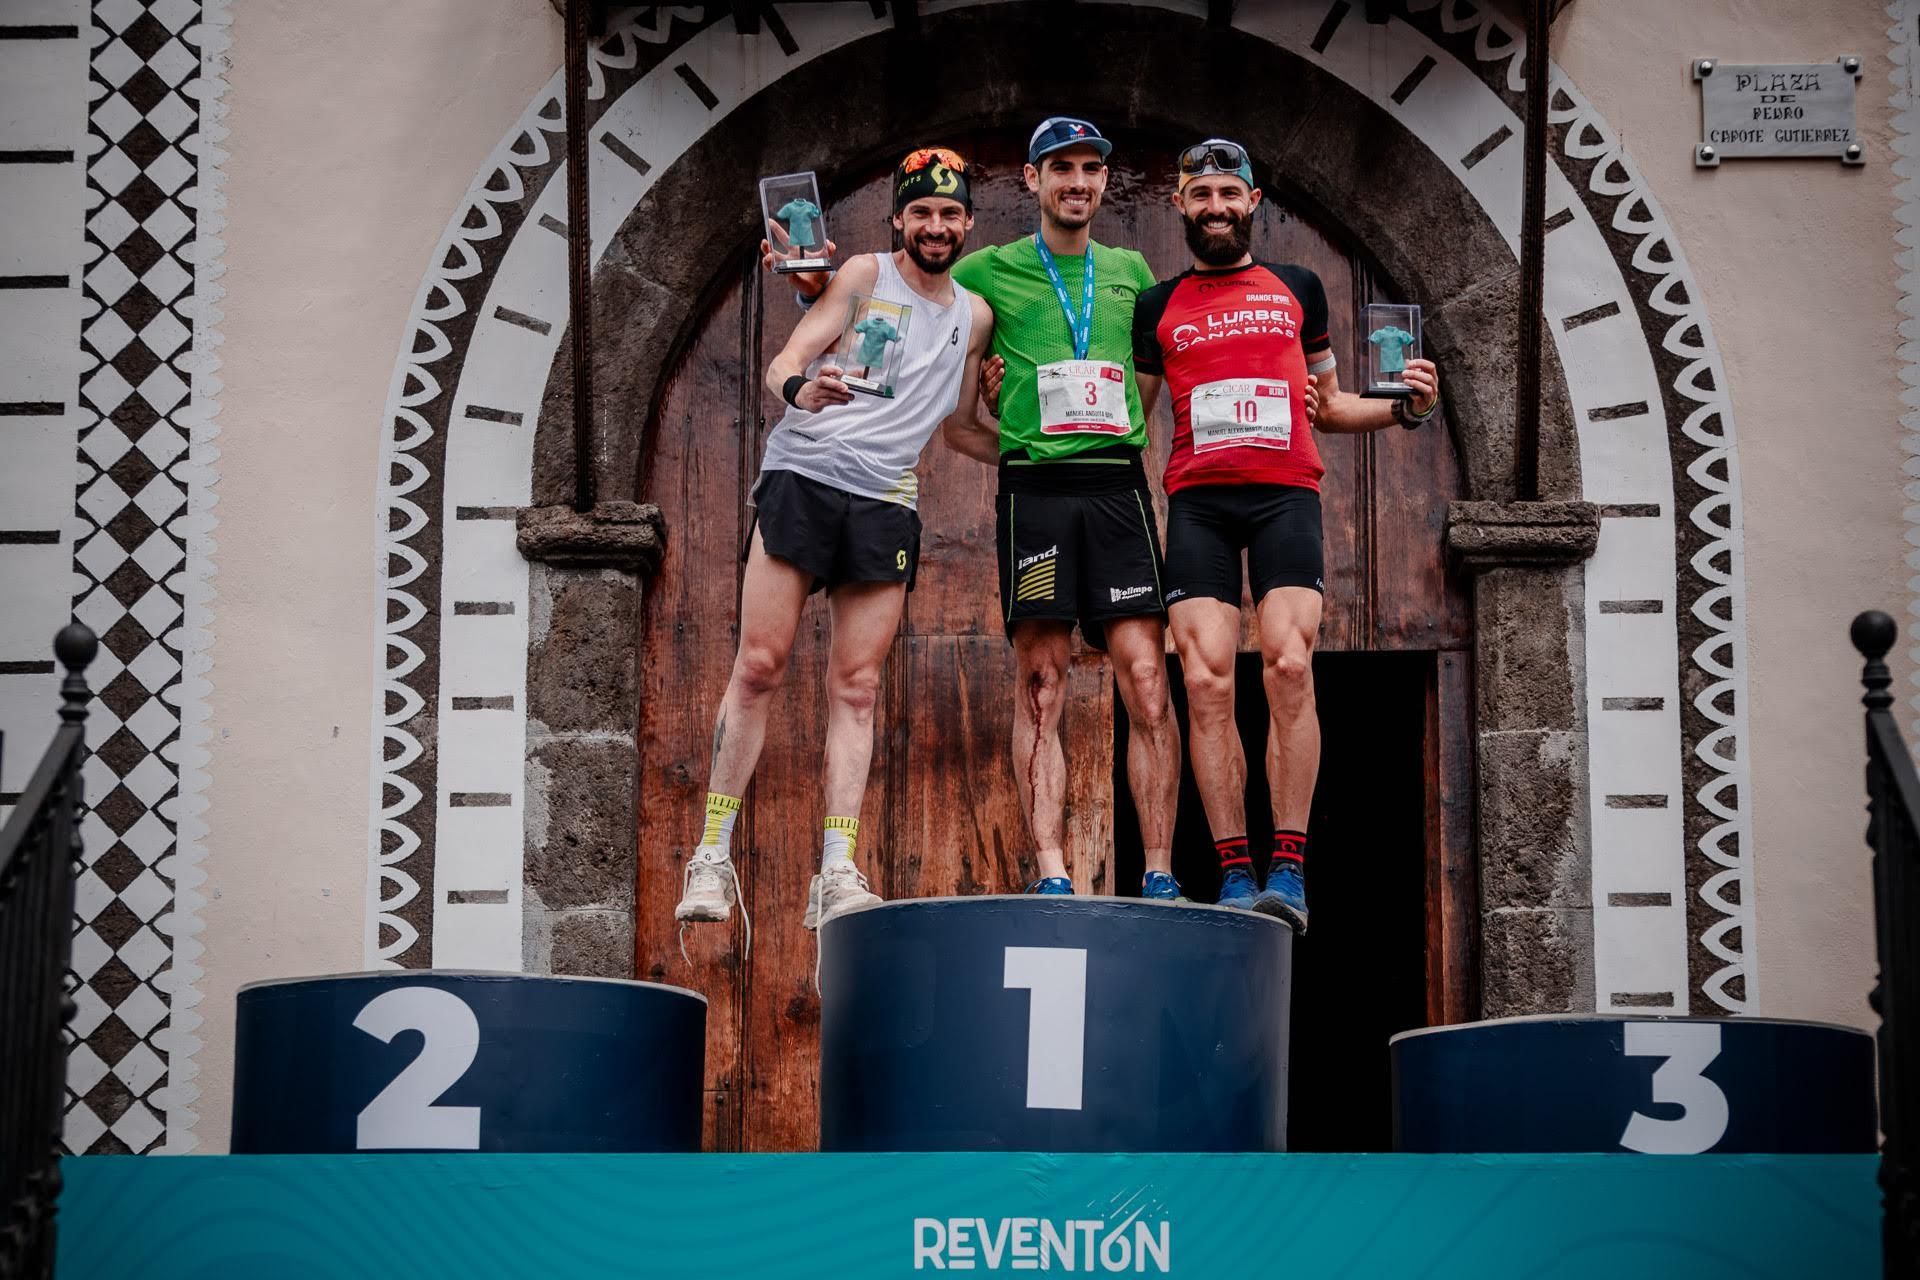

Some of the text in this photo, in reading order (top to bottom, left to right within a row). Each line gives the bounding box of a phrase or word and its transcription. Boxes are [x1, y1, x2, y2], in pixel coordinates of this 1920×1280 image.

[1736, 73, 1821, 92] PLAZA
[1761, 95, 1796, 104] DE
[1752, 106, 1804, 120] PEDRO
[1710, 128, 1850, 143] CAPOTE GUTIERREZ
[1207, 310, 1296, 327] LURBEL
[1176, 326, 1295, 352] CANARIAS
[1084, 382, 1097, 406] 3
[1233, 400, 1258, 424] 10
[1004, 947, 1087, 1111] 1
[352, 987, 481, 1150] 2
[1620, 1022, 1729, 1154] 3
